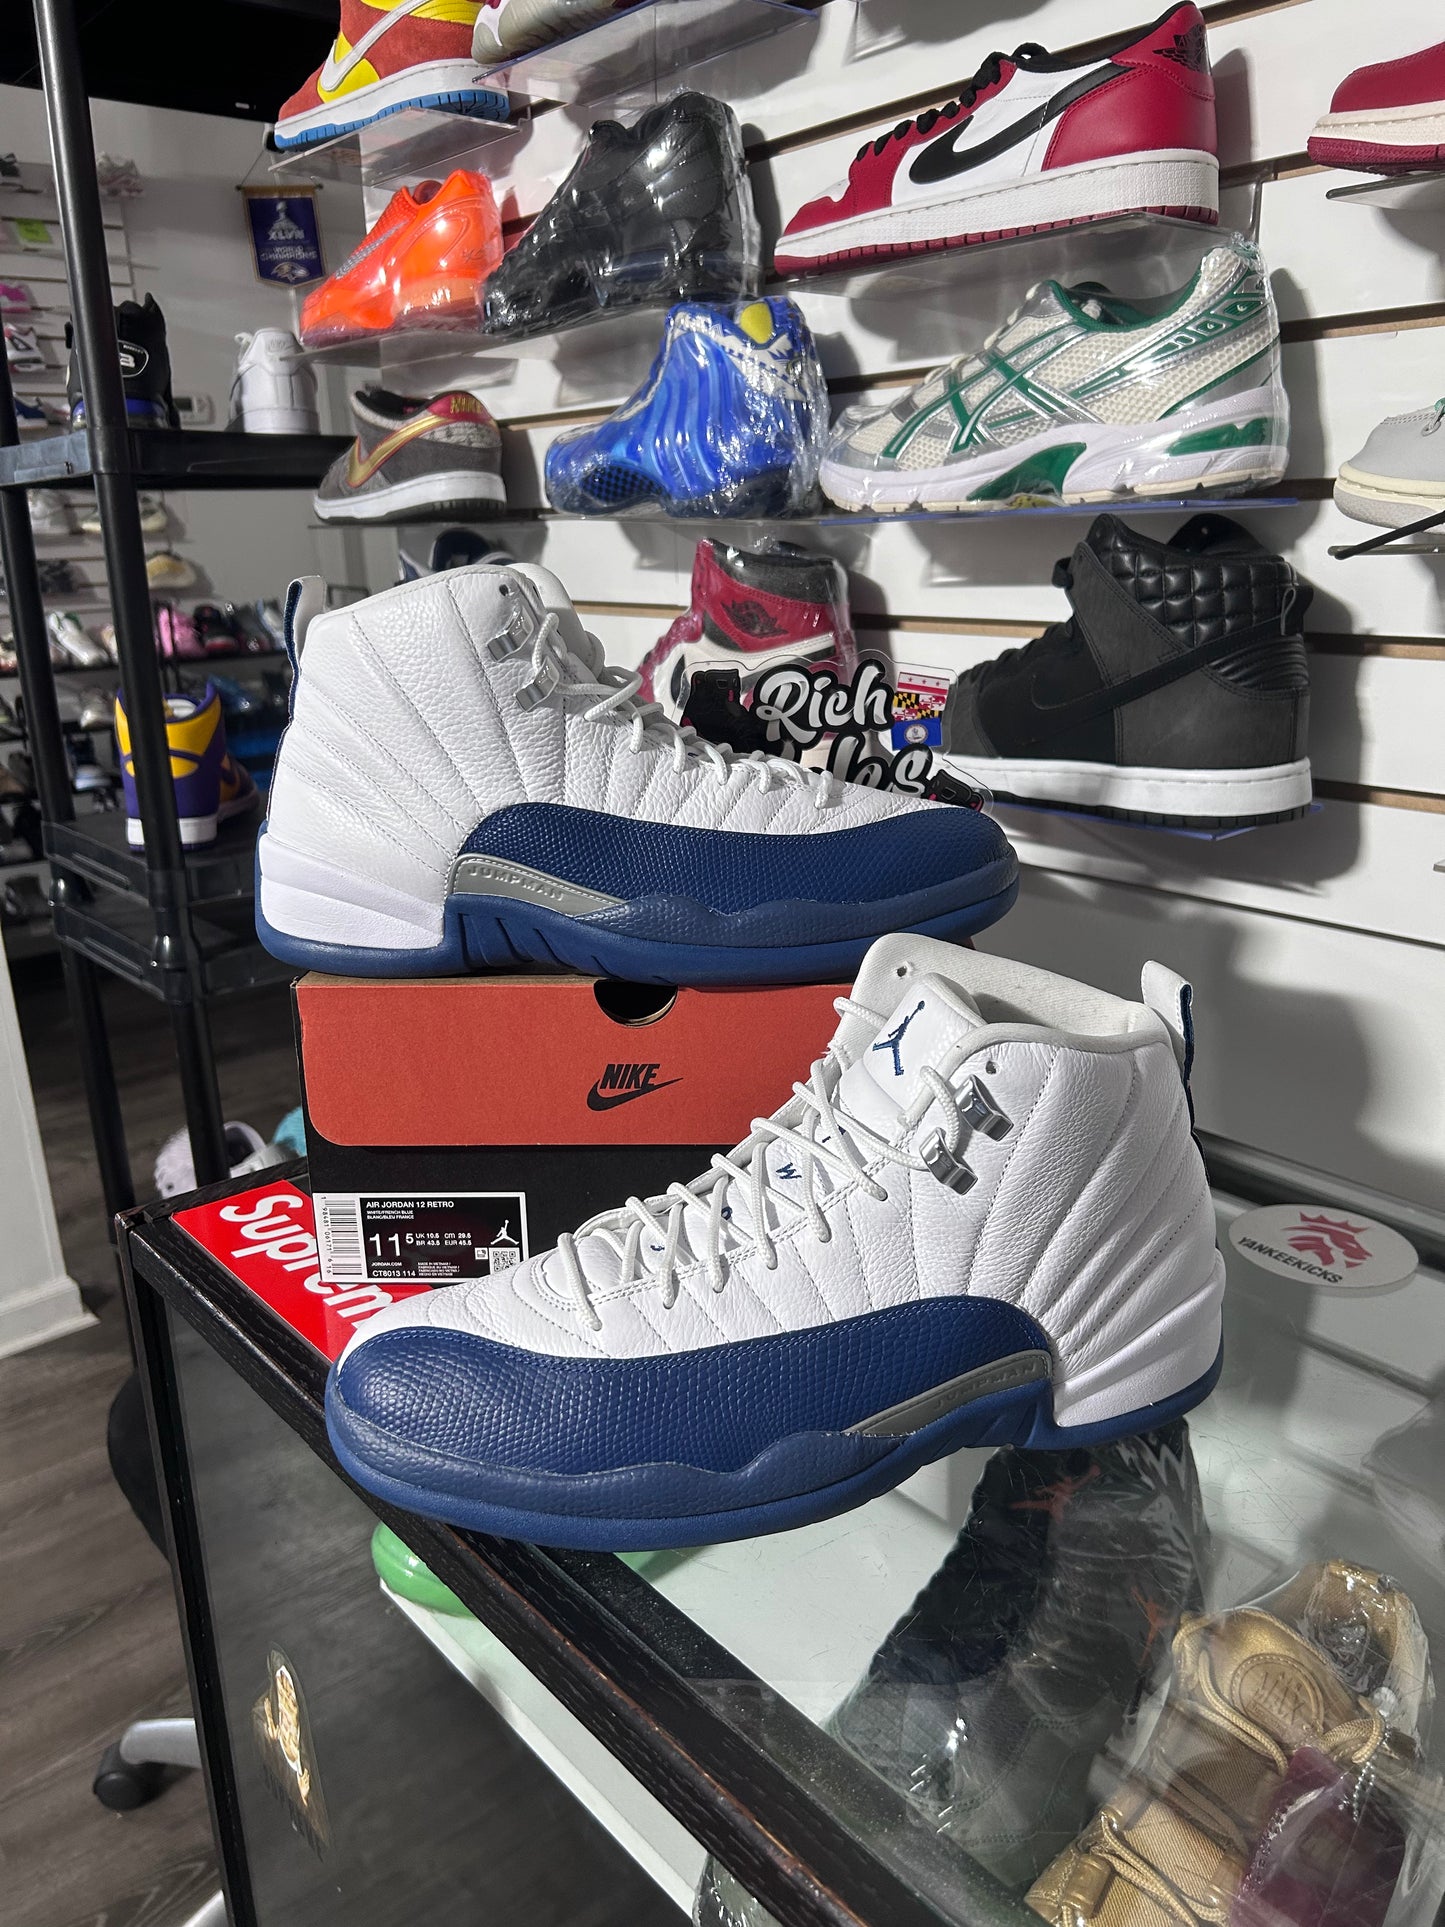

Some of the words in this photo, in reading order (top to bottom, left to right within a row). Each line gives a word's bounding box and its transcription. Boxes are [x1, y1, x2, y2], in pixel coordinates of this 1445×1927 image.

[756, 665, 888, 744] Rich
[467, 865, 565, 902] JUMPMAN
[600, 1063, 660, 1090] NIKE
[1237, 1236, 1343, 1284] YANKEEKICKS
